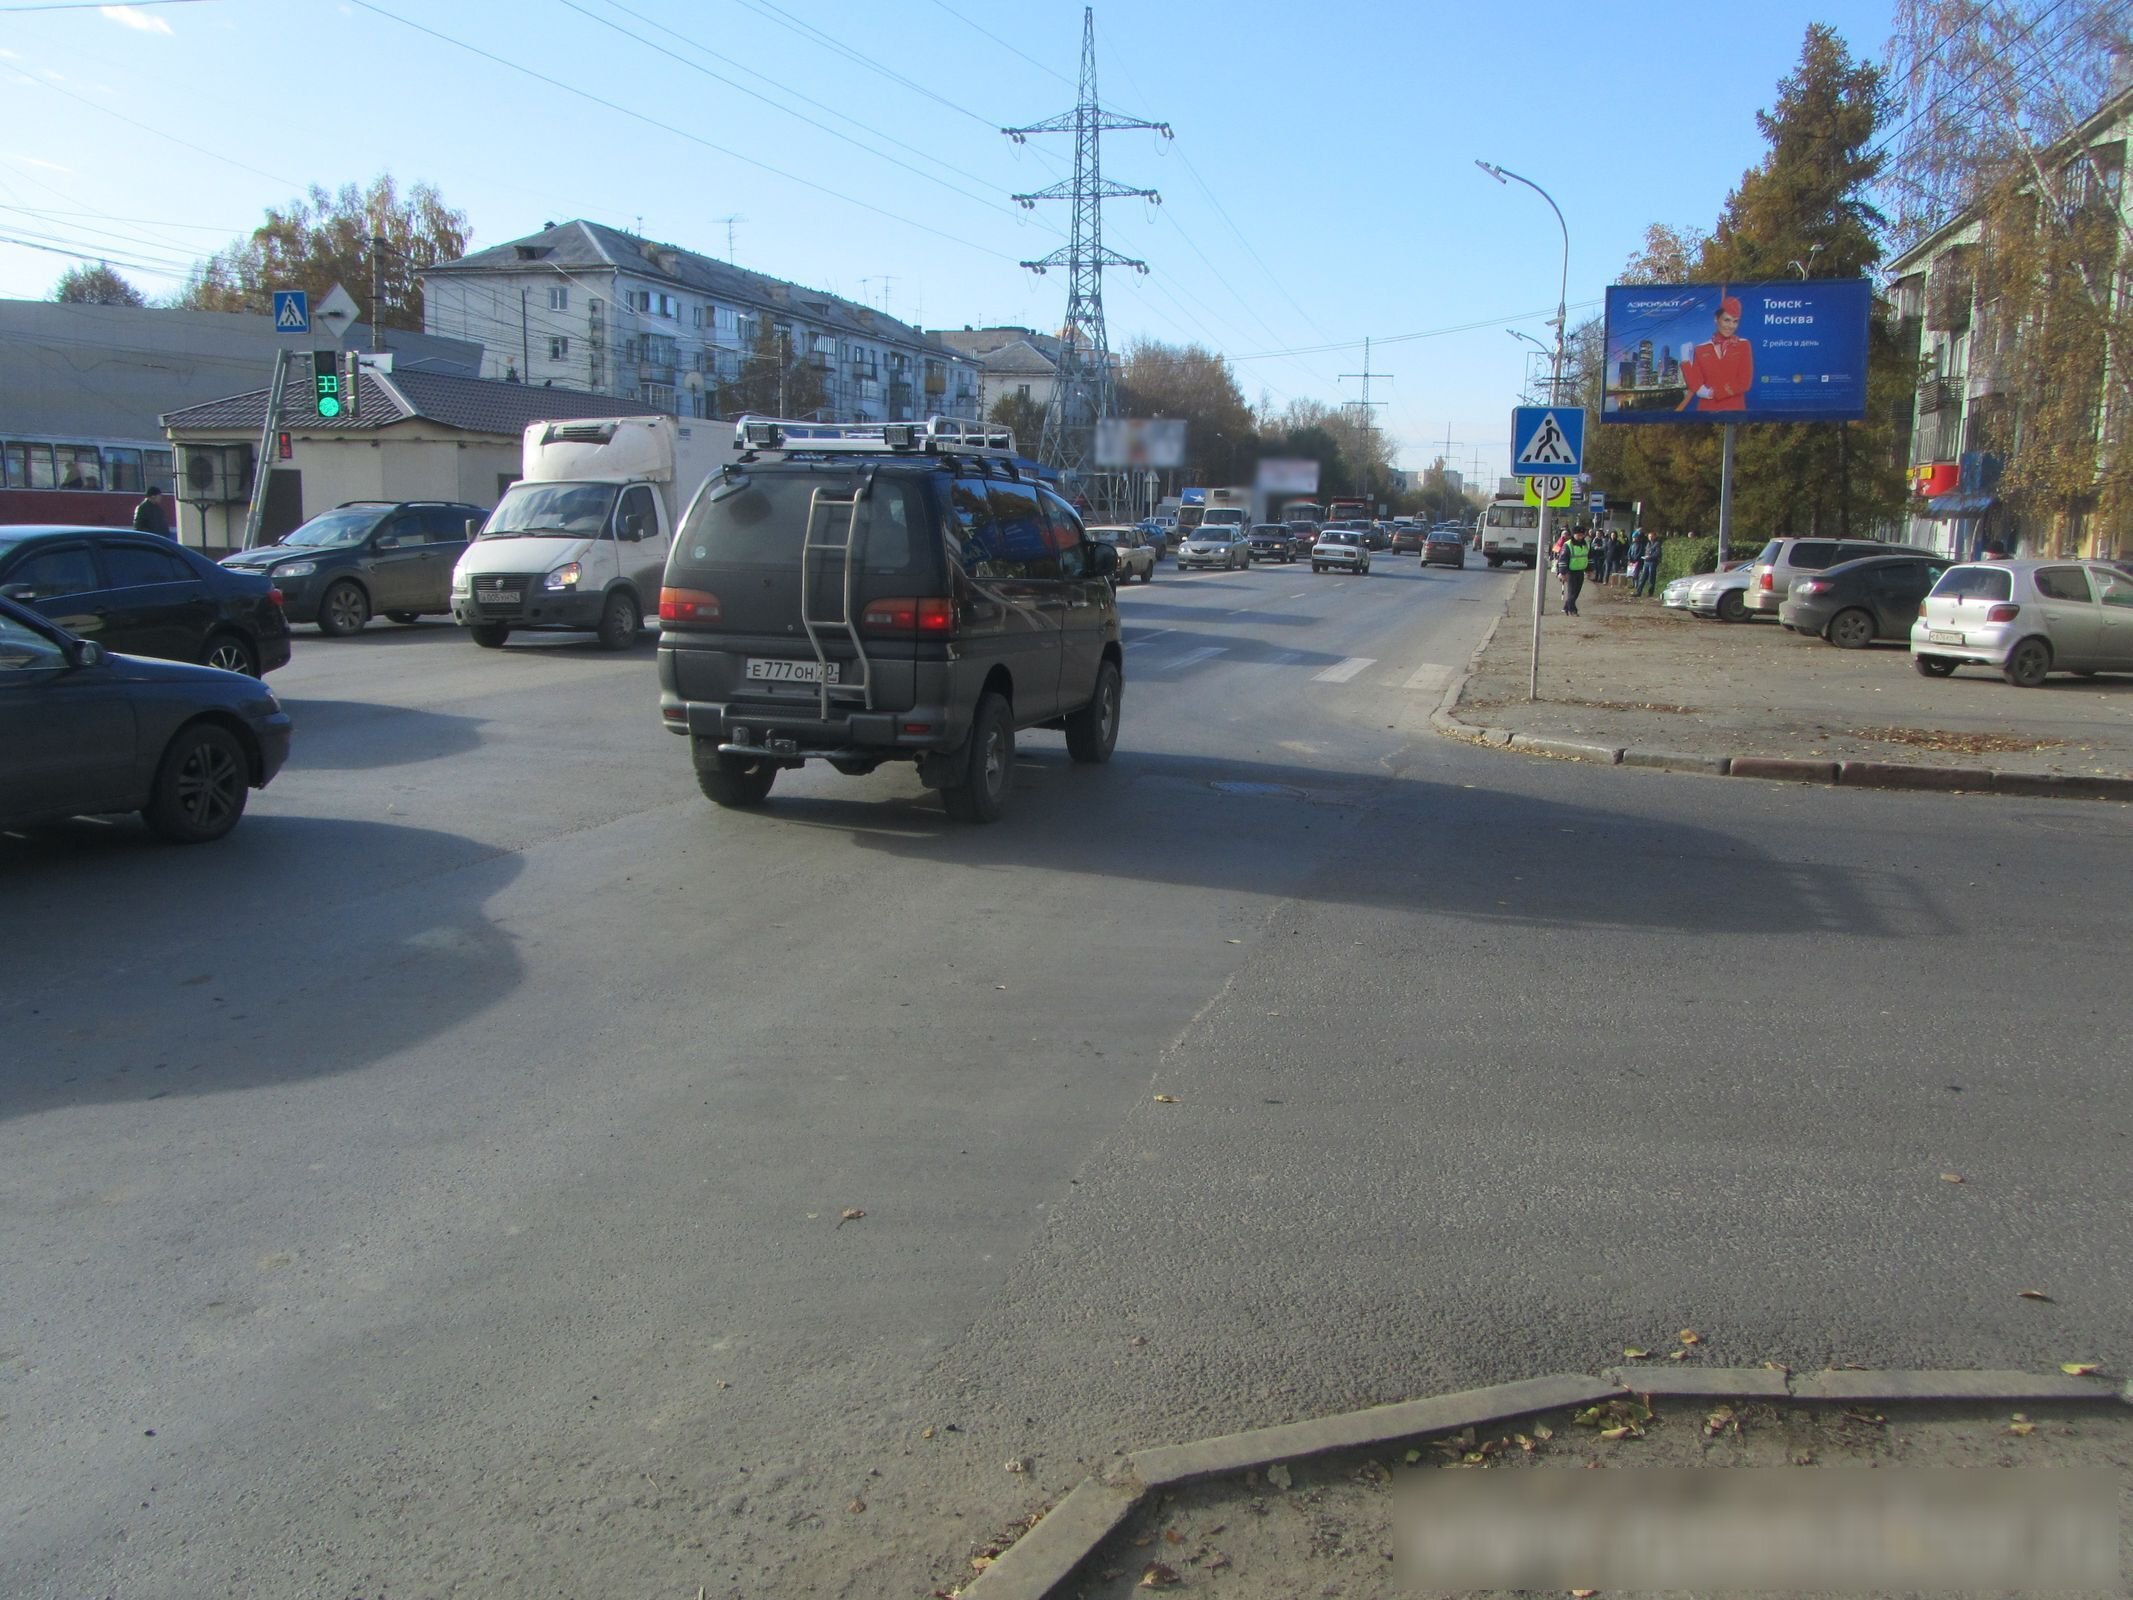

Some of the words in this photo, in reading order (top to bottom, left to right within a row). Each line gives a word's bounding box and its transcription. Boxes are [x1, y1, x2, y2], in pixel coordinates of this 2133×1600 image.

[1627, 300, 1680, 308] АЭРОФЛОТ
[1763, 298, 1802, 309] Томск
[1764, 314, 1814, 325] Москва
[1769, 339, 1792, 348] рейса
[1800, 340, 1819, 348] день
[318, 375, 337, 393] 33
